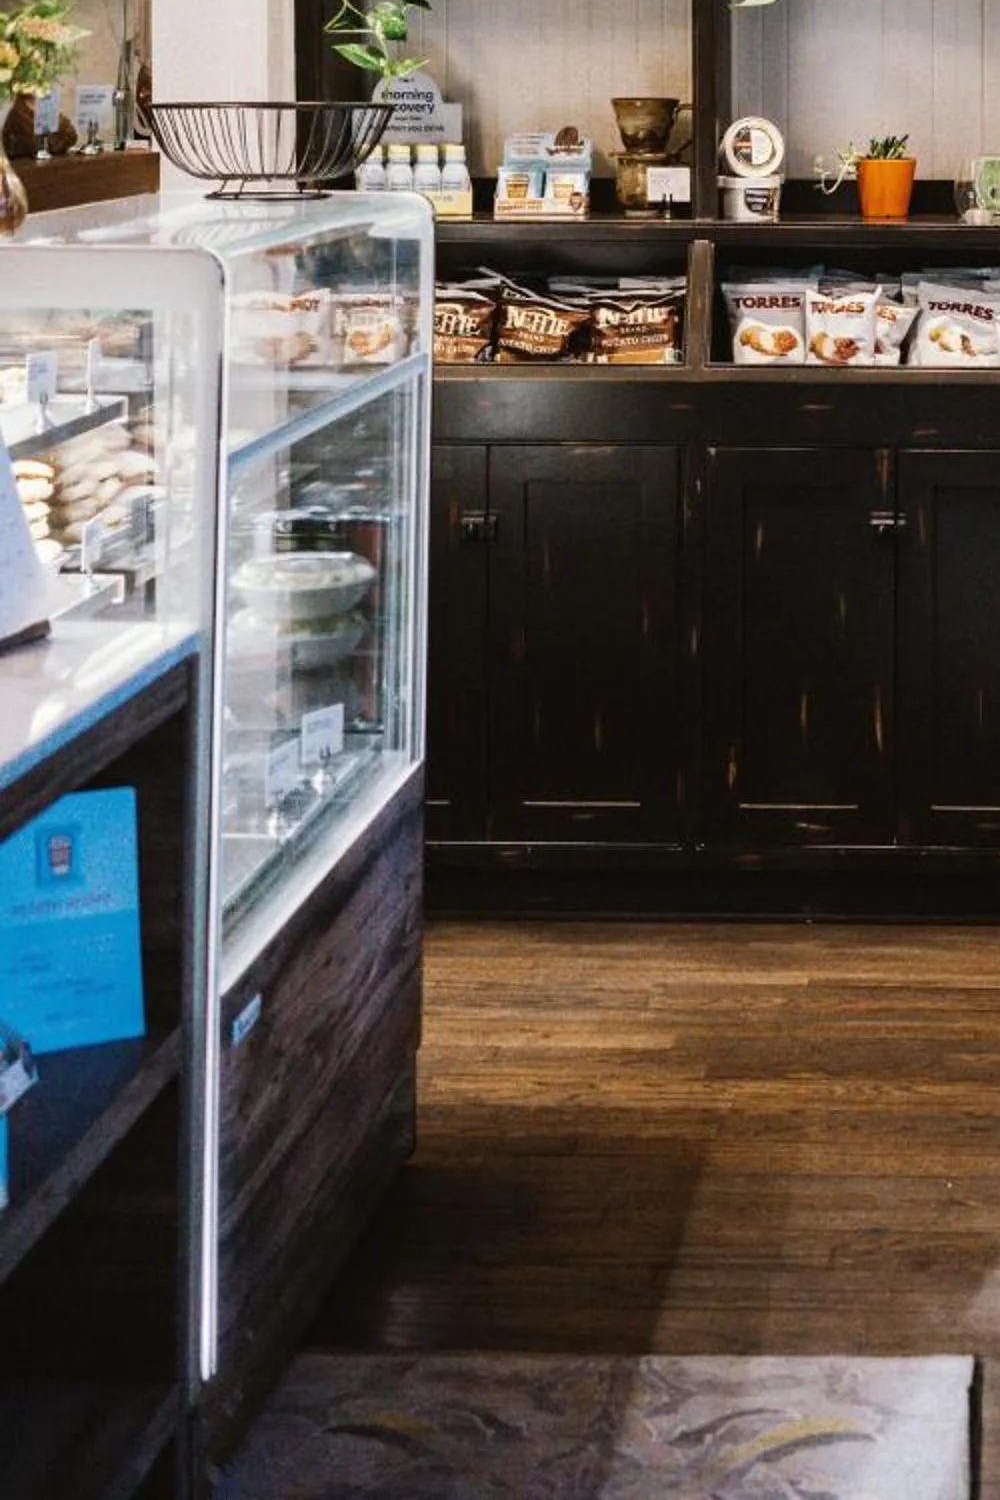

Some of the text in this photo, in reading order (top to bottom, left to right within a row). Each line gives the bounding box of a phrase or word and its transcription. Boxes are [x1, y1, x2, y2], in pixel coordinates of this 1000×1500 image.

[393, 103, 434, 113] covery
[734, 296, 801, 309] TORRES
[928, 301, 994, 321] TORRES
